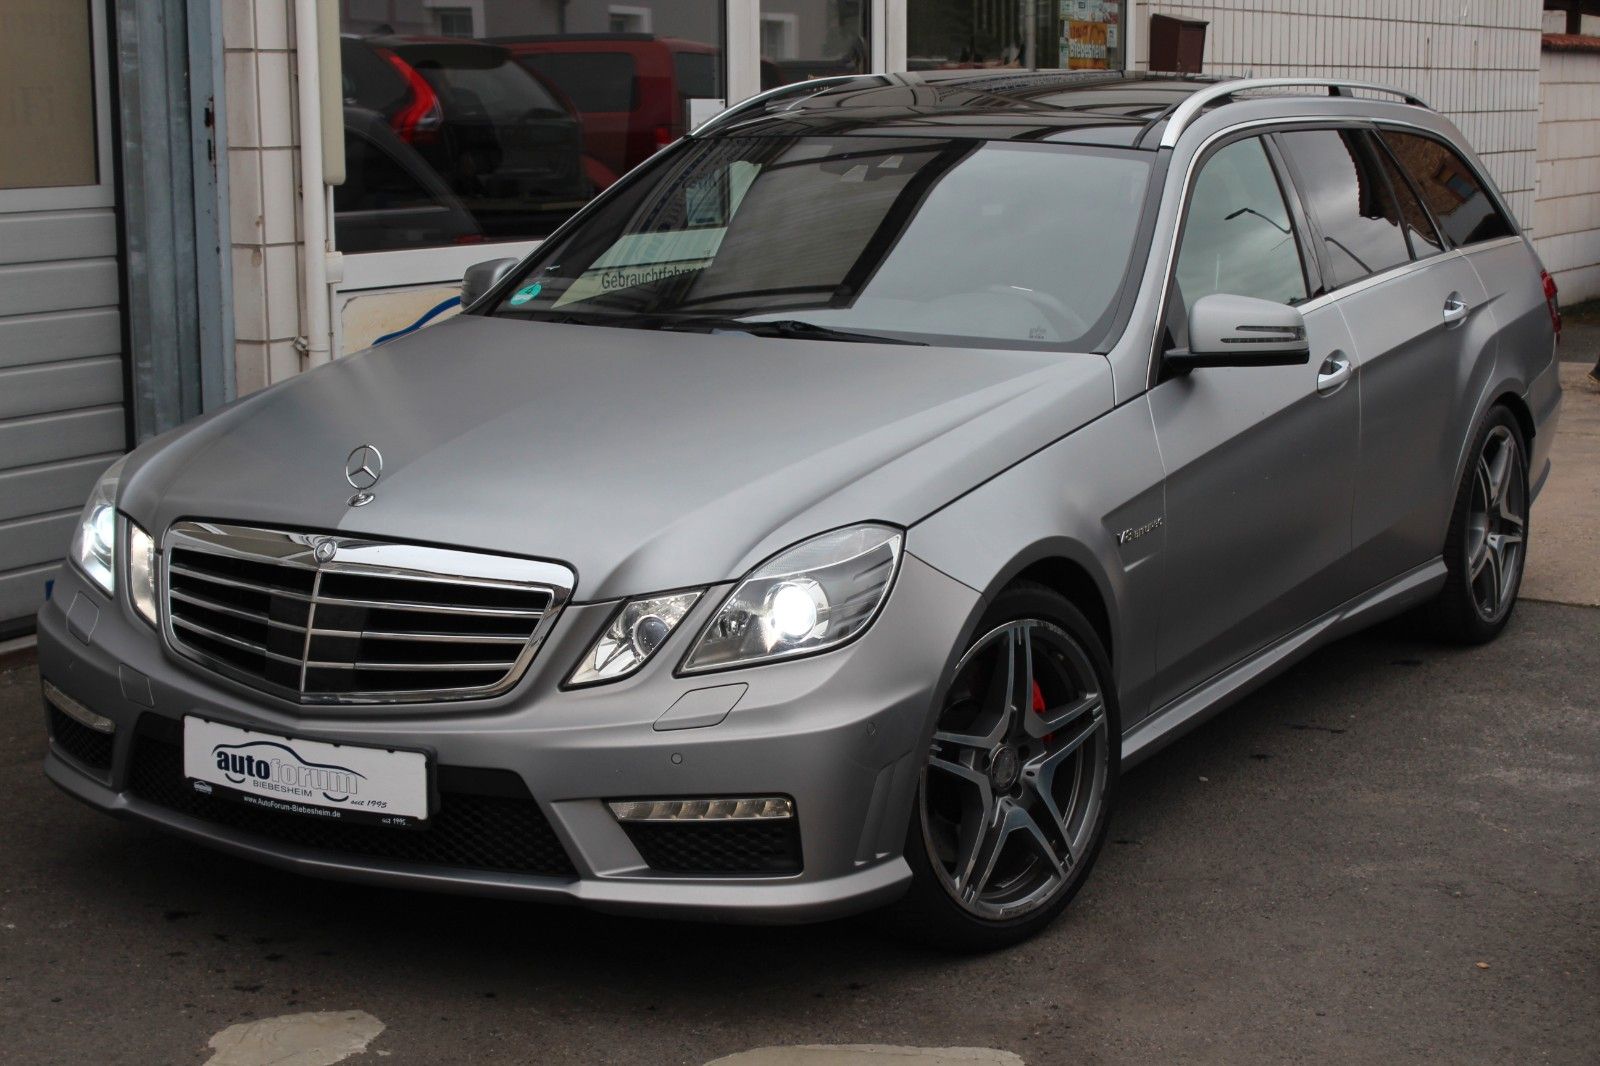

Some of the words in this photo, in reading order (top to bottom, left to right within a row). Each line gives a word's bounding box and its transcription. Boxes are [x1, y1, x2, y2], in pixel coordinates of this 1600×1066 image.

[216, 750, 358, 795] autoforum
[252, 779, 313, 798] BIEBESHEIM
[243, 796, 341, 818] www.AutoForum-Biebesheim.de
[366, 799, 389, 809] 1995
